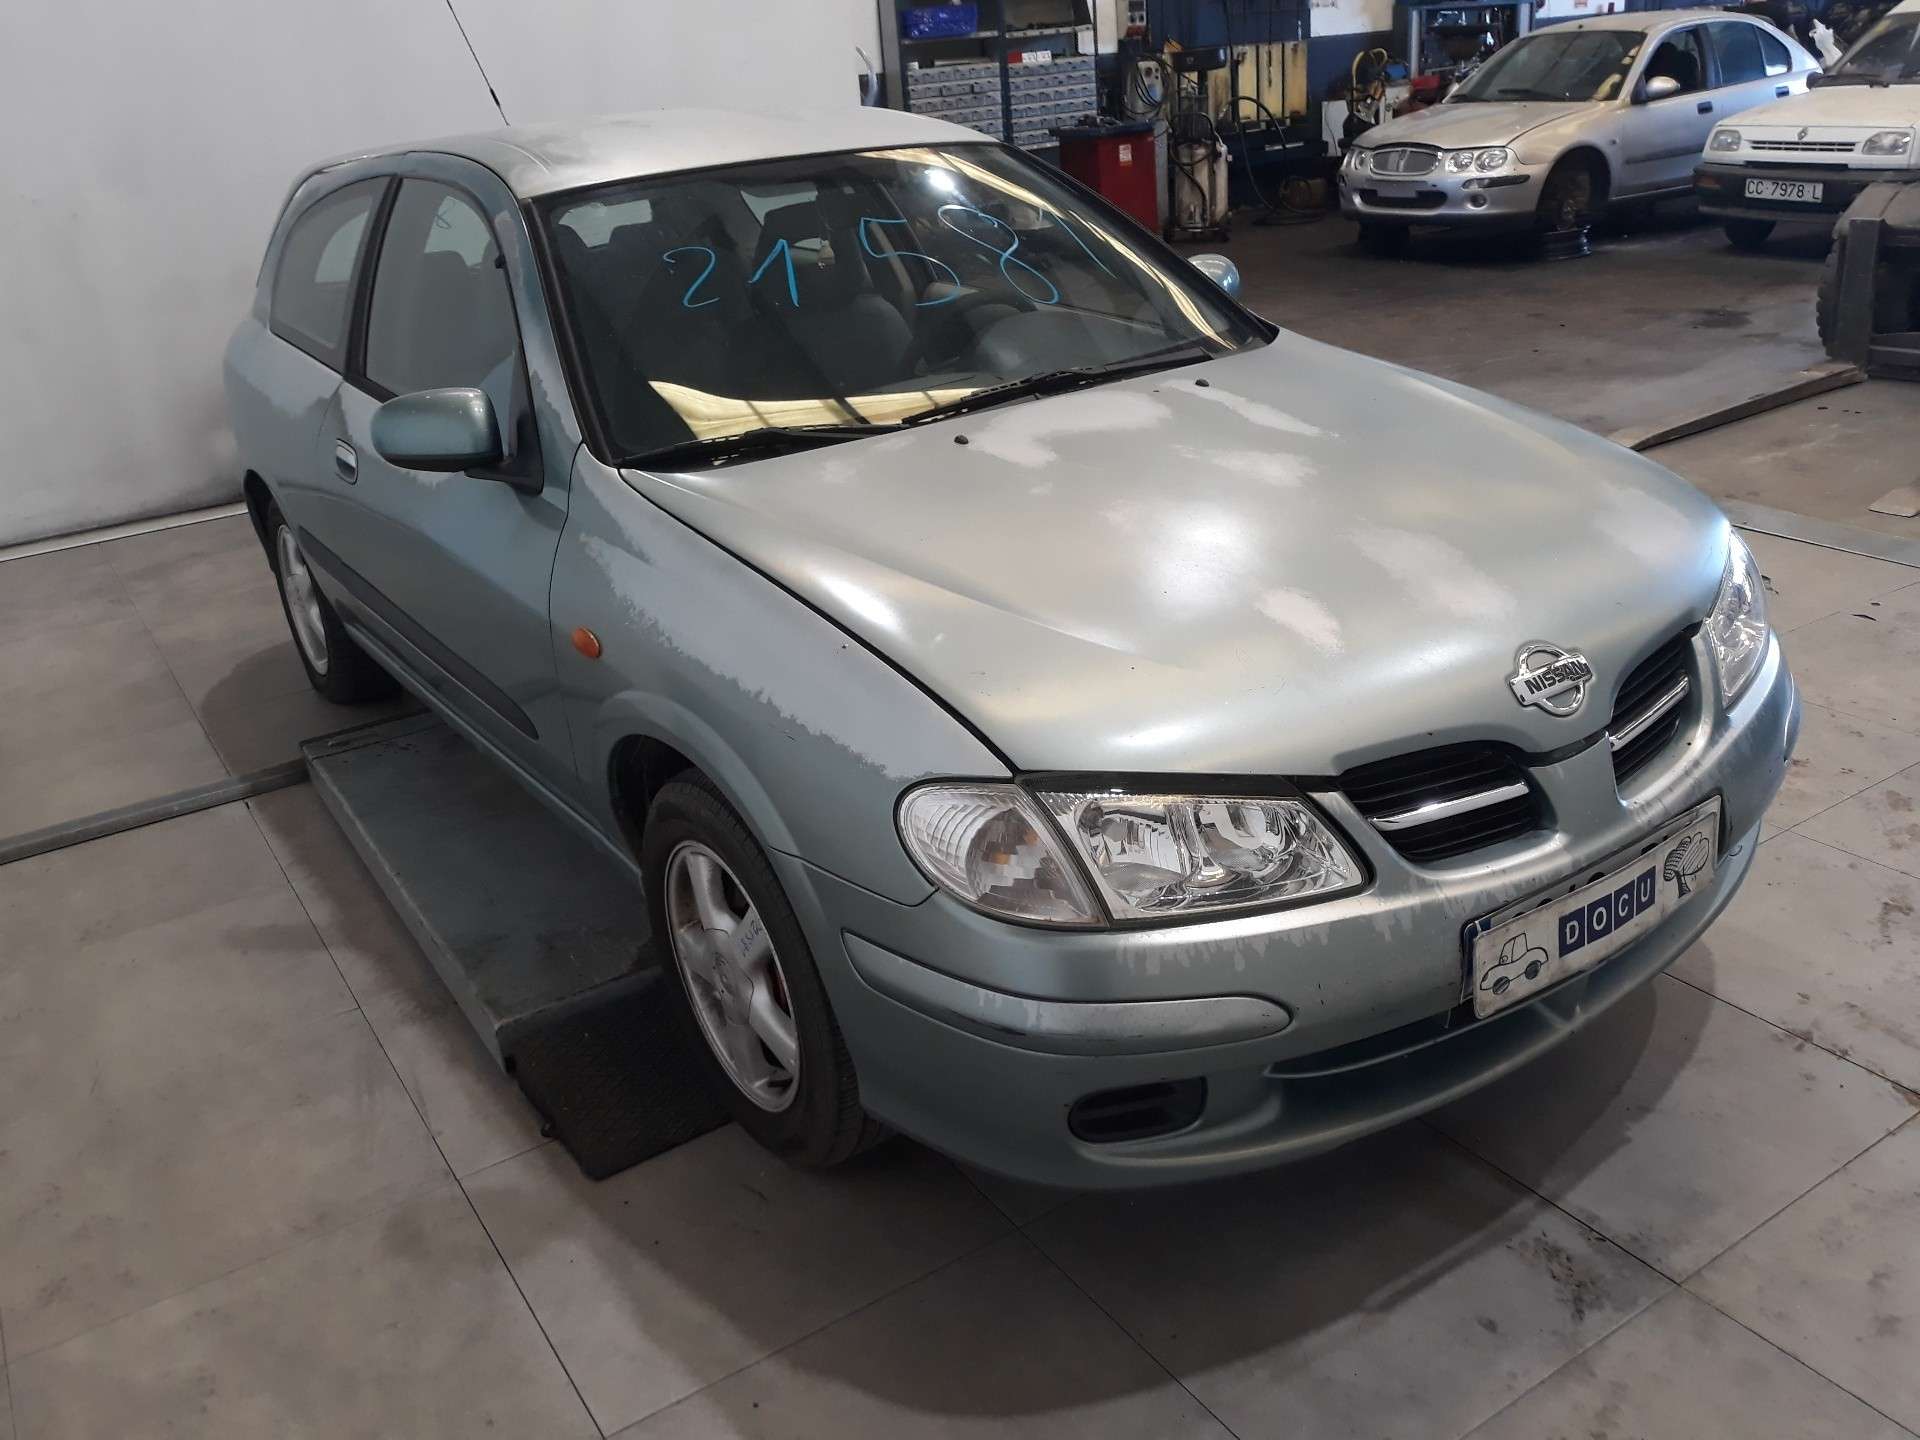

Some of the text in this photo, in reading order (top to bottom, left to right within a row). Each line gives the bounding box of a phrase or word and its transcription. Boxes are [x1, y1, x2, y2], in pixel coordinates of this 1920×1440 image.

[1771, 182, 1805, 199] 7978
[1524, 659, 1592, 695] NISSAN
[1565, 877, 1651, 945] DOCU
